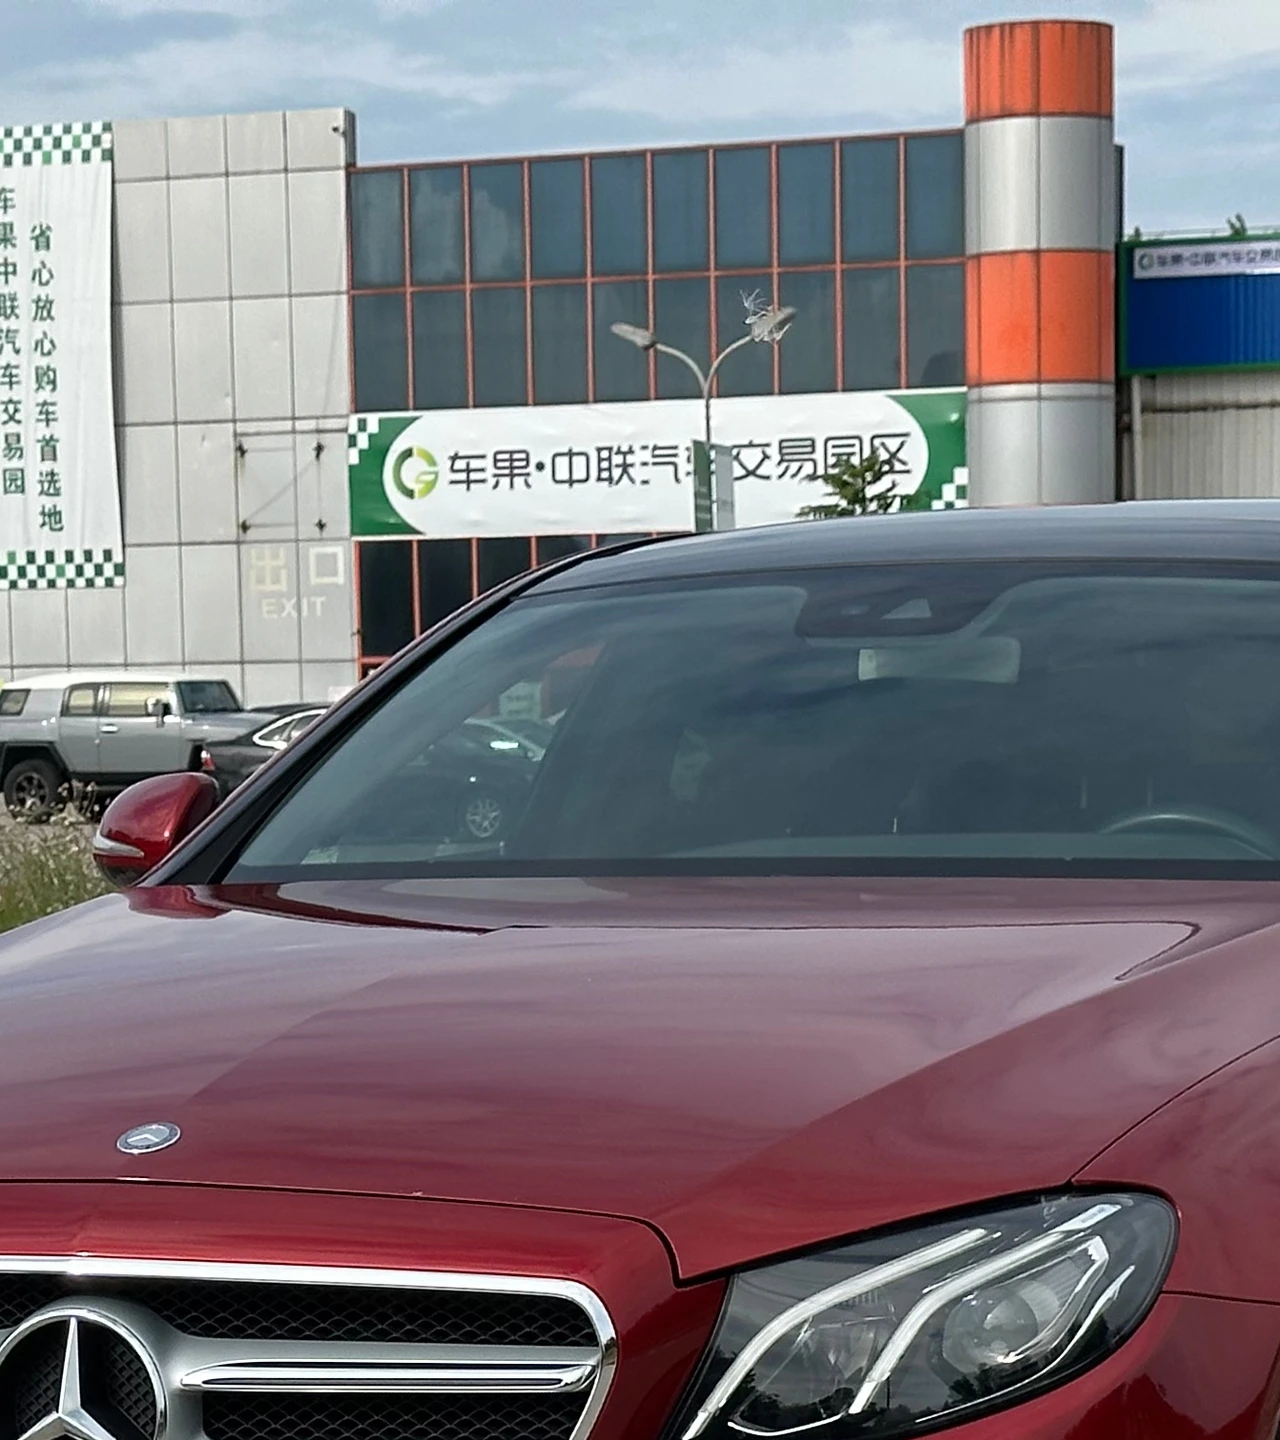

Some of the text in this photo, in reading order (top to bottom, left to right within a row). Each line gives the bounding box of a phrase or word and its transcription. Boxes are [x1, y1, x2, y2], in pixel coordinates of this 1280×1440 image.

[30, 223, 65, 533] 省心放心购车首选地
[447, 430, 912, 491] 车果·中联汽交易园区
[249, 546, 345, 592] 出口
[261, 596, 327, 618] EXIT
